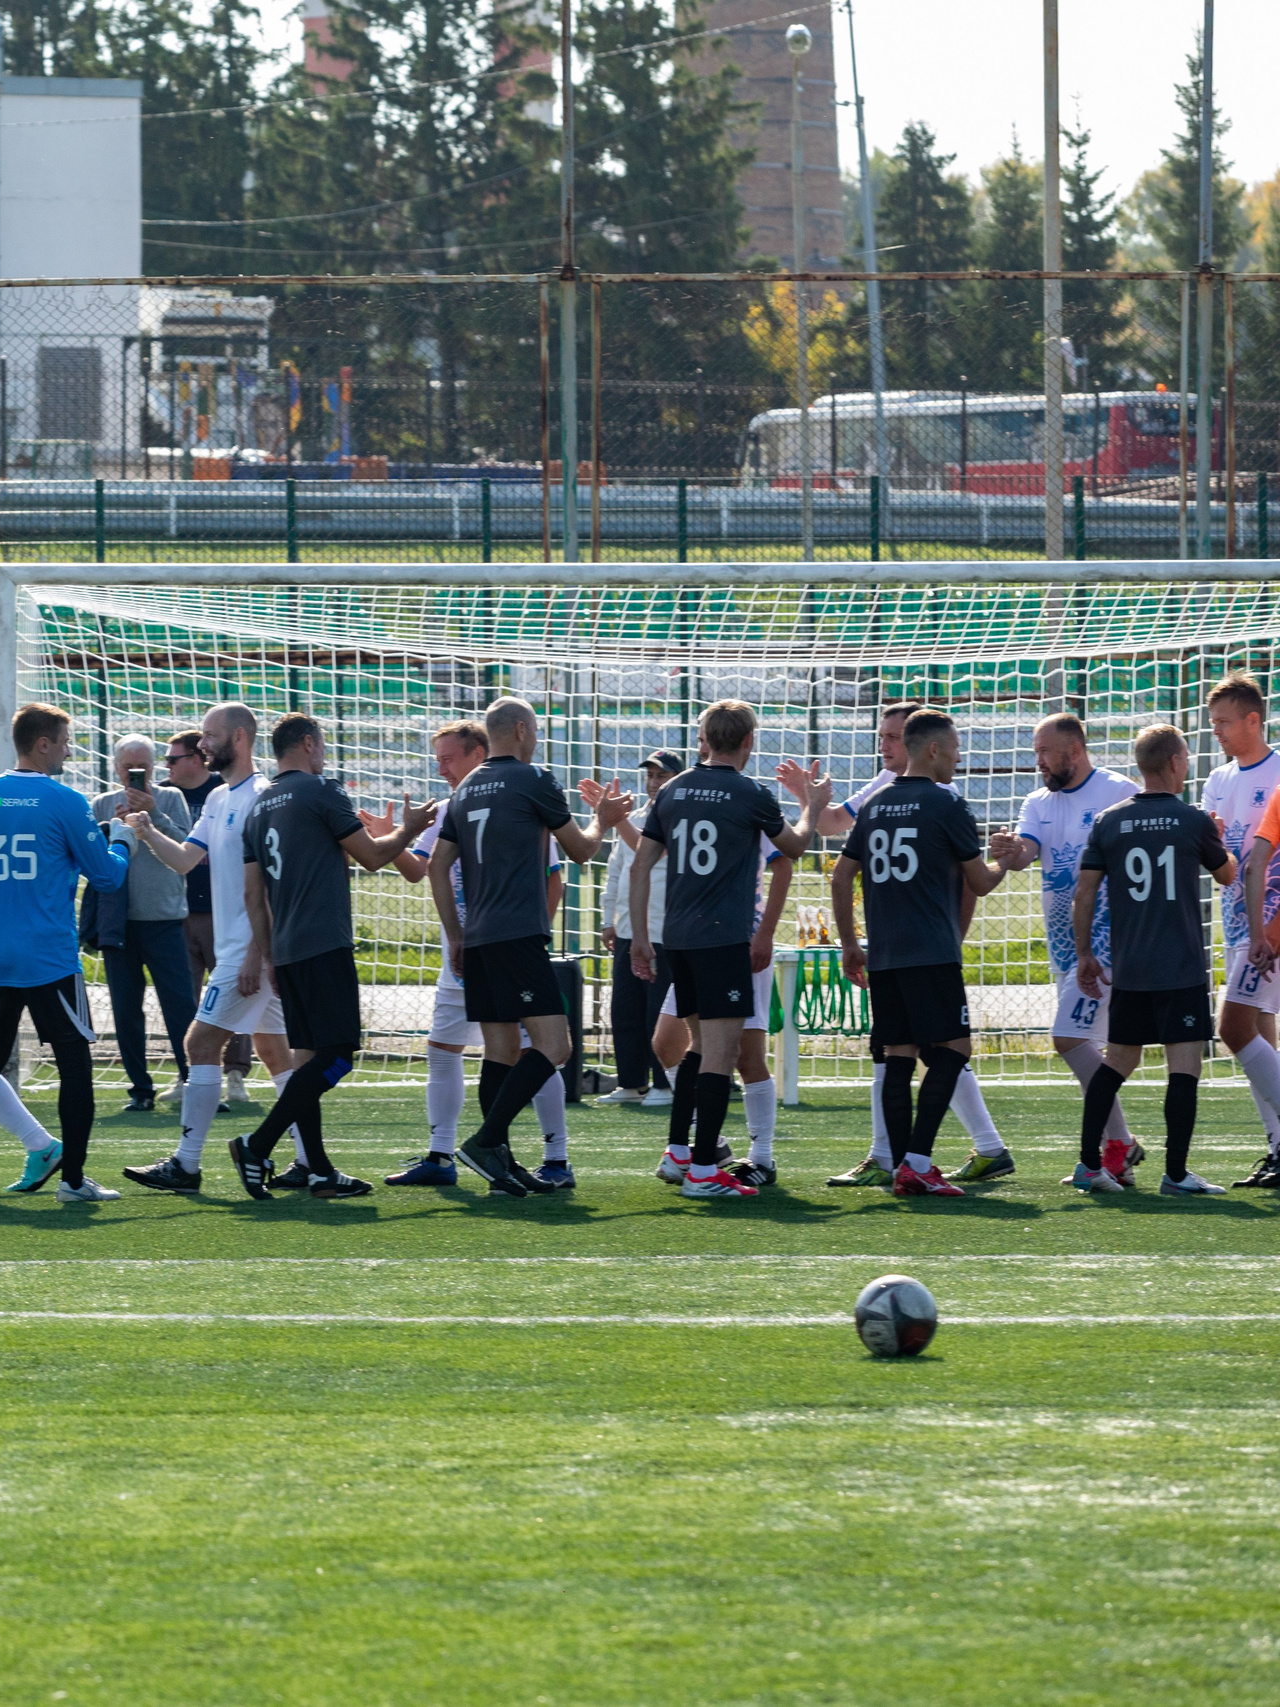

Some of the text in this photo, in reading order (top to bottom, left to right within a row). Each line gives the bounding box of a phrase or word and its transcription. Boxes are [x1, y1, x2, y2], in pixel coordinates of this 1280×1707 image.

[265, 827, 283, 880] 3
[467, 808, 491, 864] 7
[672, 819, 718, 875] 18
[868, 828, 919, 883] 85
[1125, 845, 1176, 902] 91
[1237, 964, 1261, 993] 13
[1070, 997, 1099, 1024] 43
